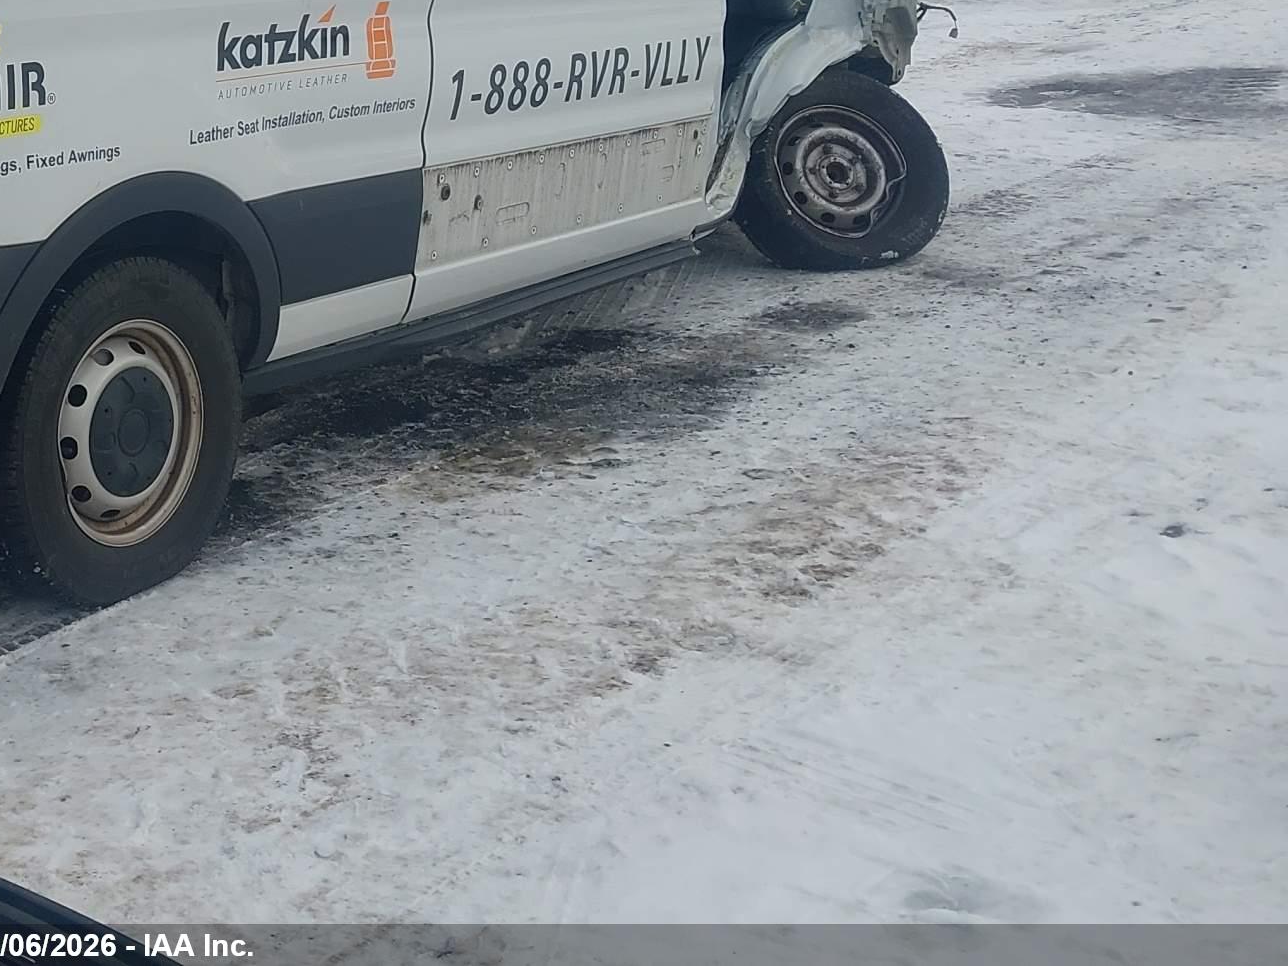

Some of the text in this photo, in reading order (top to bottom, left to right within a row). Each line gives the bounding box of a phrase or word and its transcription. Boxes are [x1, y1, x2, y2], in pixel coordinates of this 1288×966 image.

[217, 73, 349, 101] AUTOMOTIVE LEATHER
[449, 35, 711, 121] 1-888-RVR-VLLY
[188, 96, 417, 145] Leather Seat Installation, Custom Interiors
[26, 152, 64, 170] Fixed
[67, 144, 121, 164] Awnings
